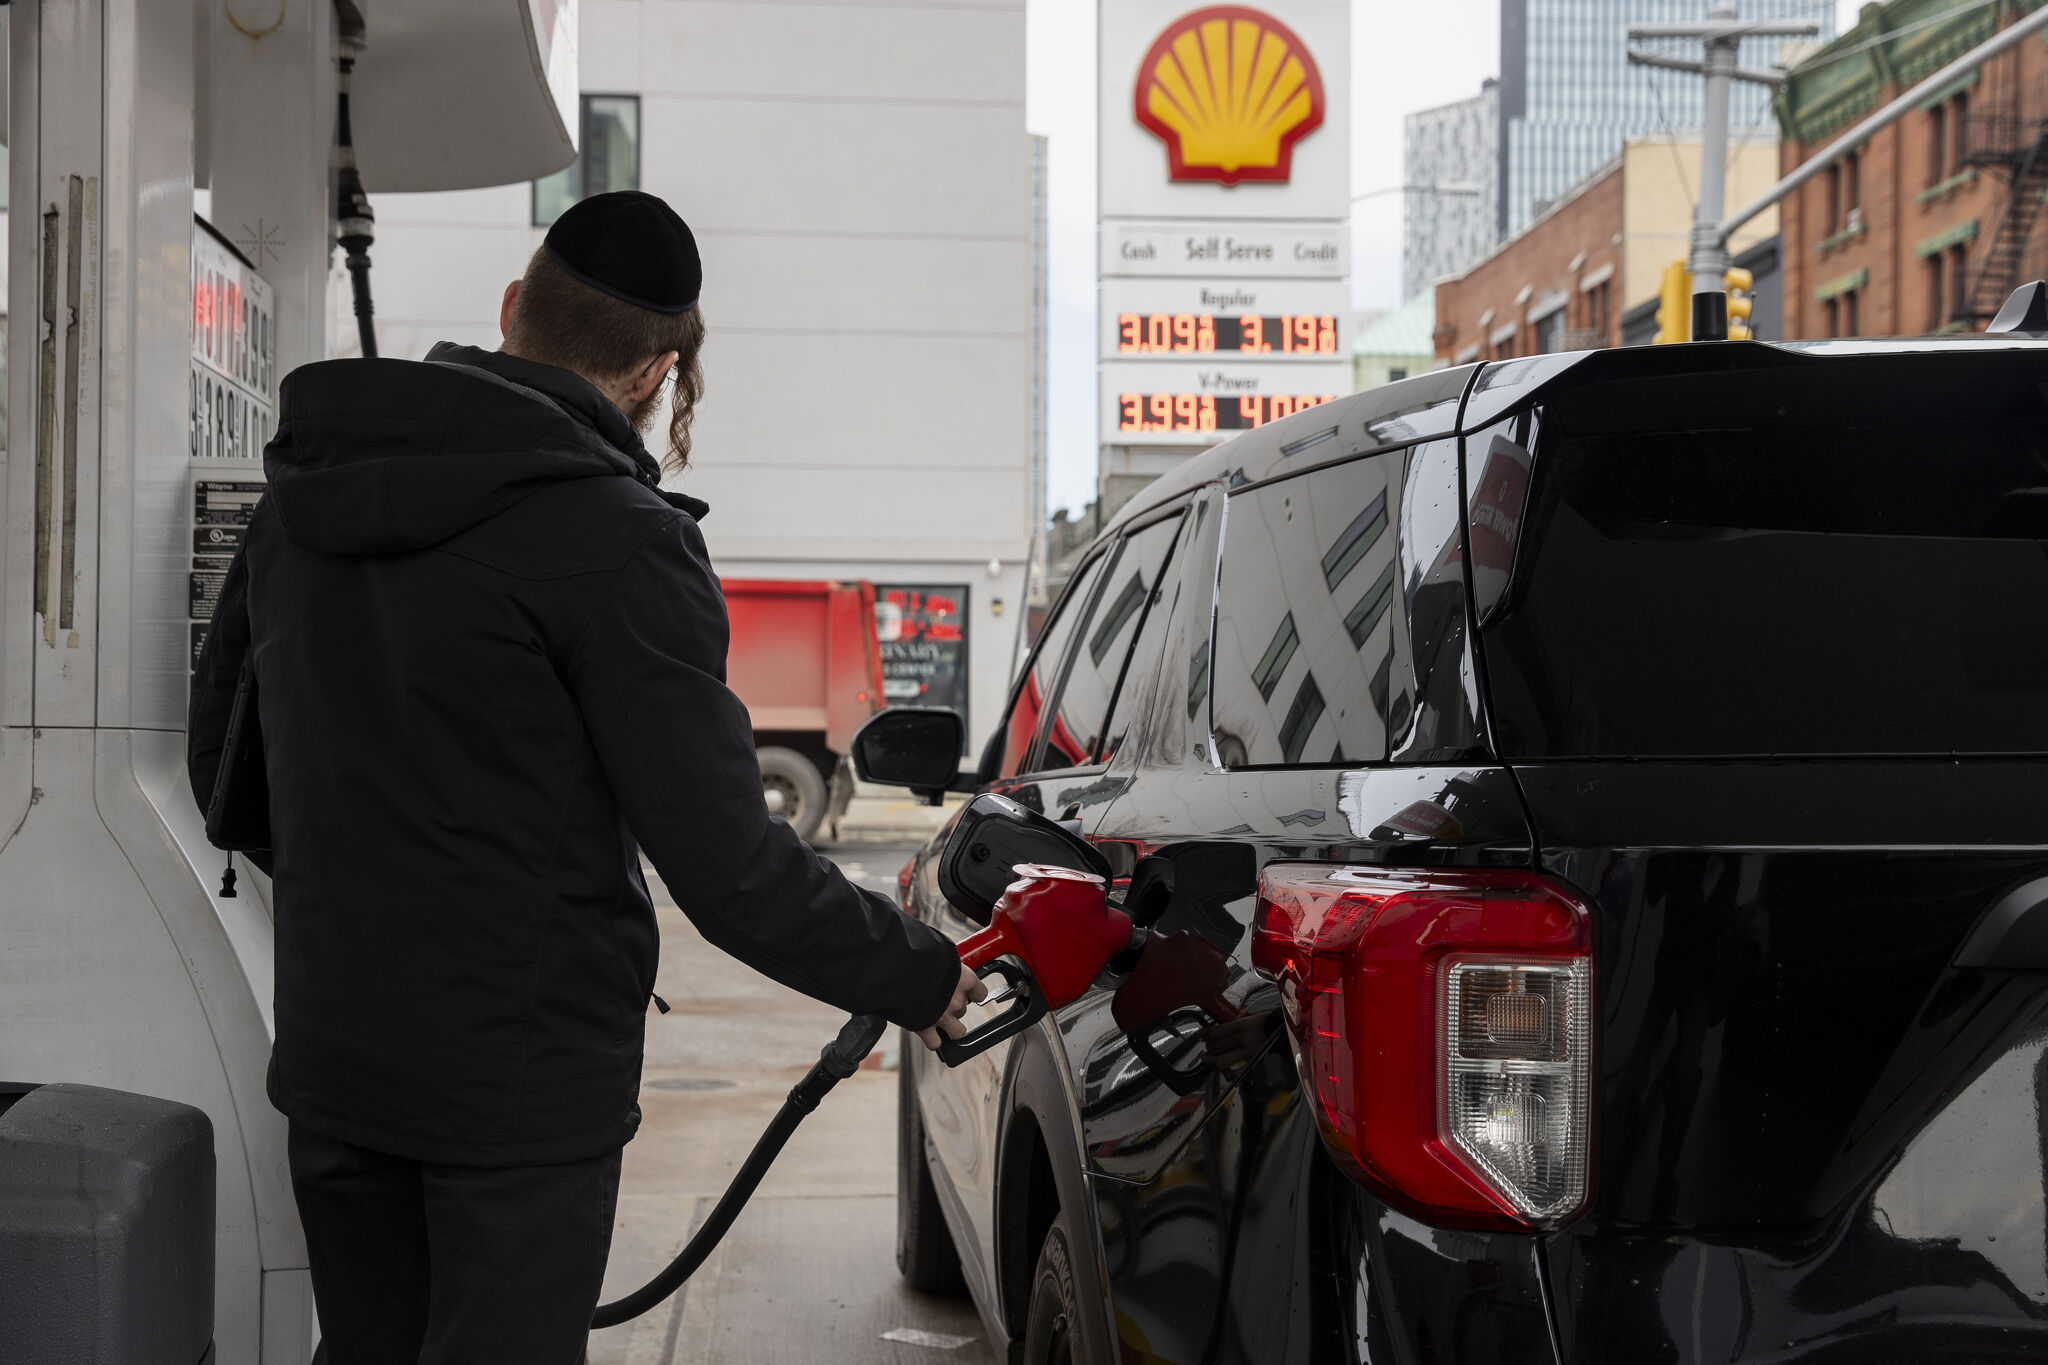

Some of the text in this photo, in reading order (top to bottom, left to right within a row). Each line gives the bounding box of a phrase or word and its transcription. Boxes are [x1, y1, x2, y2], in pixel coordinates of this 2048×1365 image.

[1121, 240, 1156, 260] Cash
[1186, 237, 1274, 260] Self Serve
[1294, 241, 1338, 261] Credit
[1201, 288, 1256, 309] Regular
[1199, 372, 1259, 390] V-Power
[207, 483, 233, 491] Wayne
